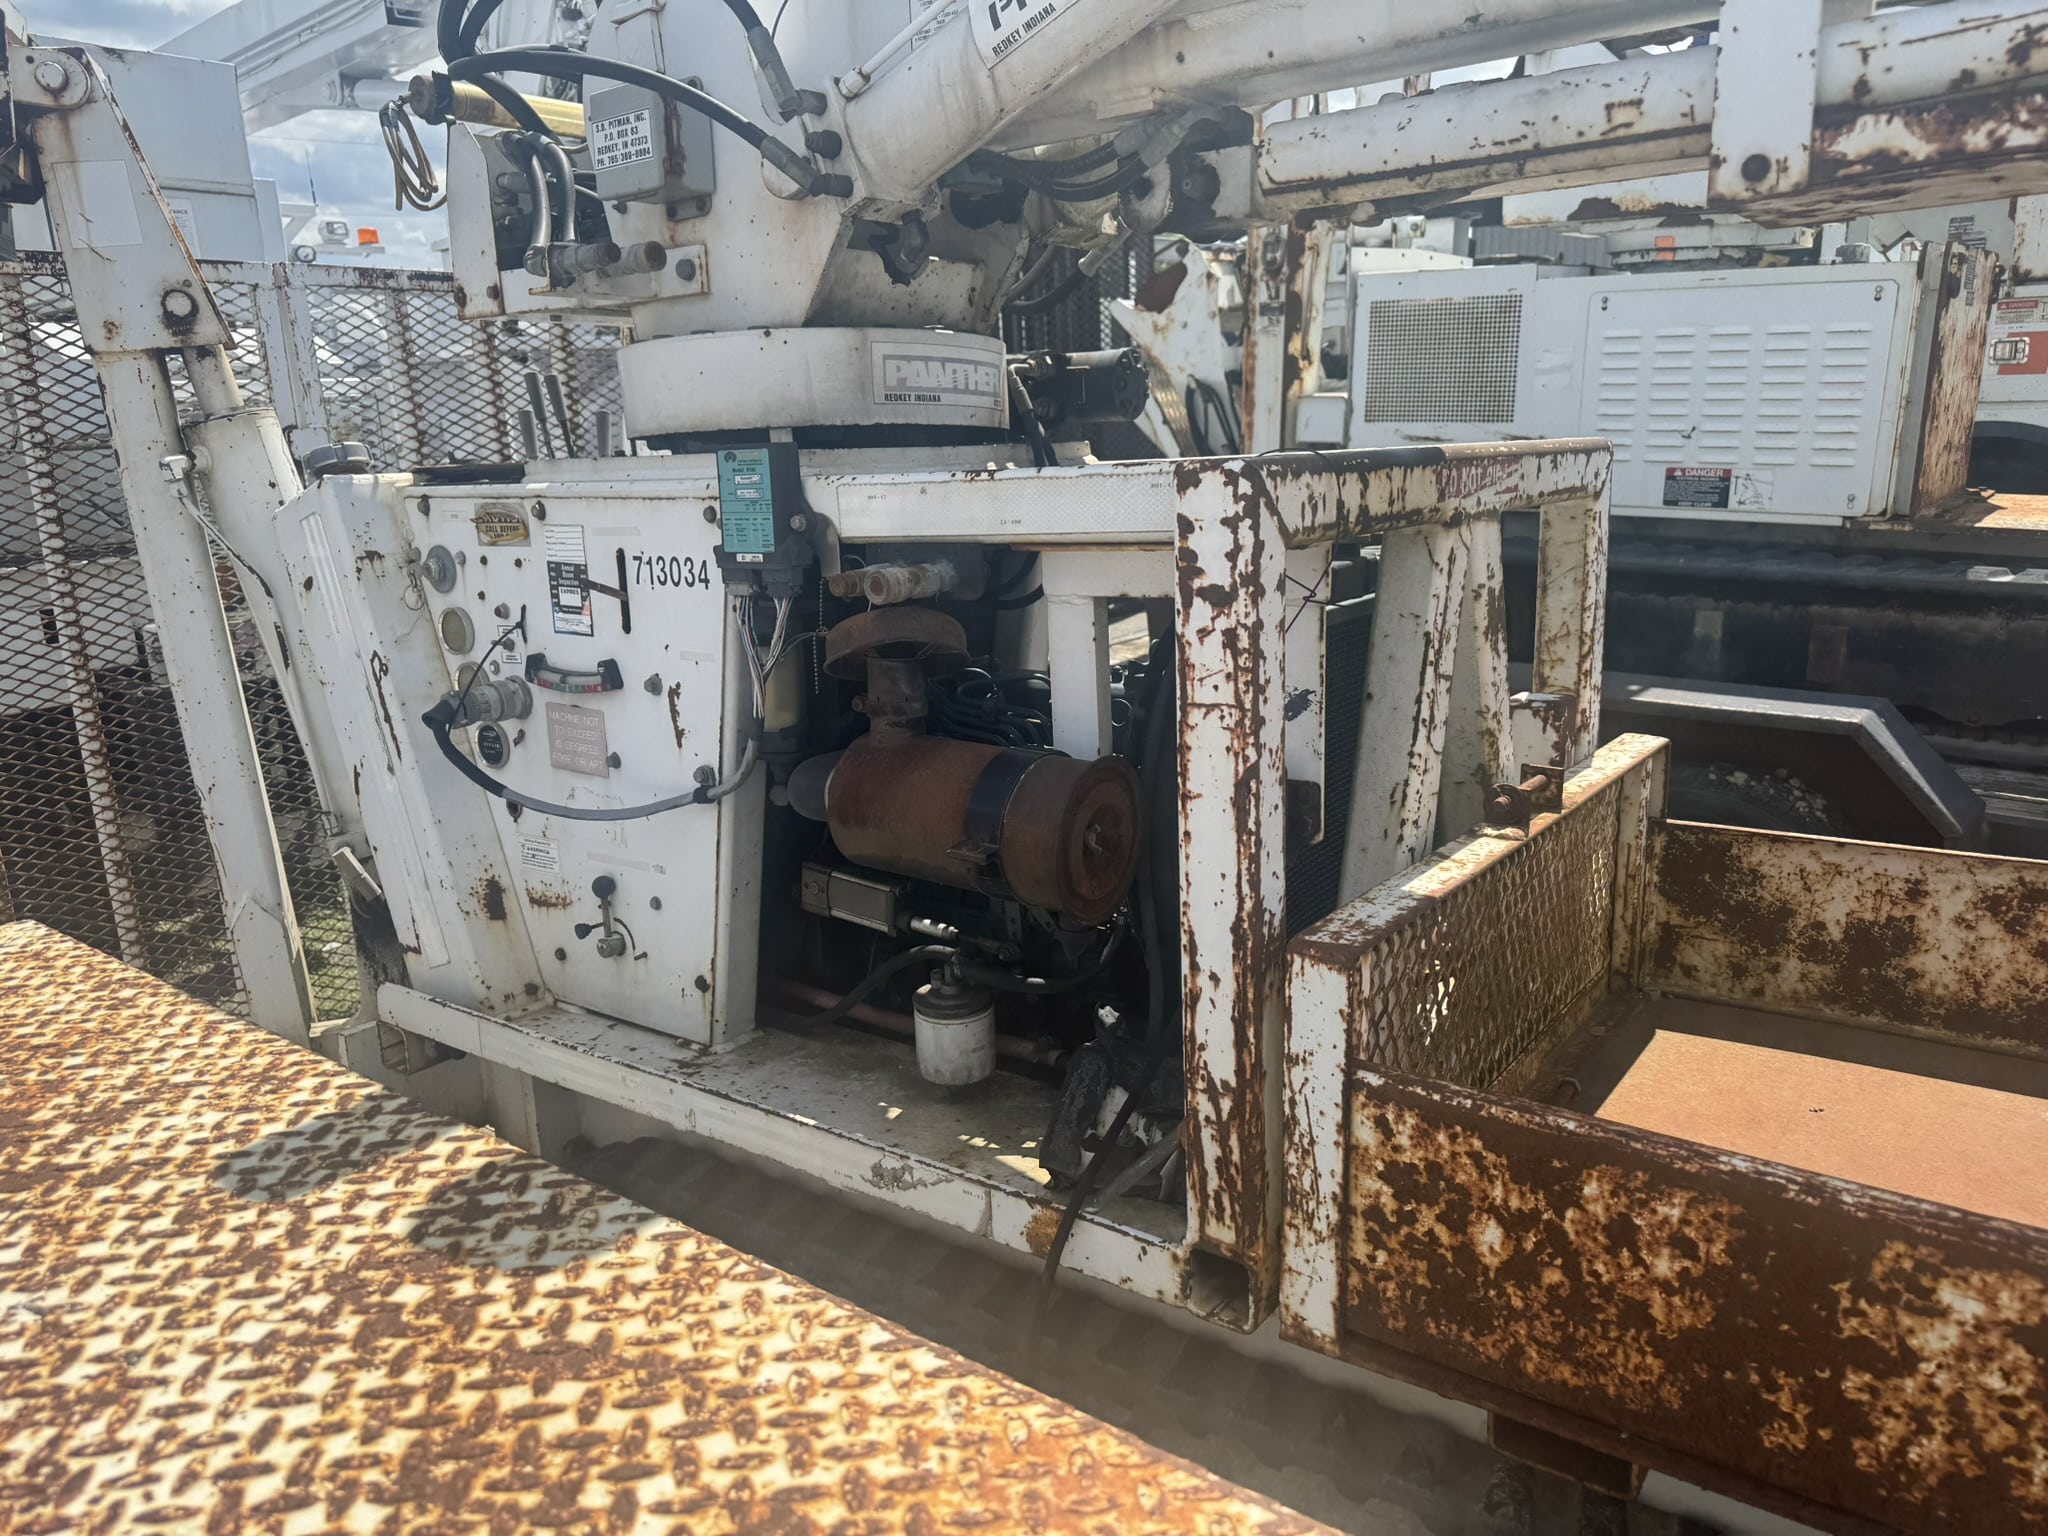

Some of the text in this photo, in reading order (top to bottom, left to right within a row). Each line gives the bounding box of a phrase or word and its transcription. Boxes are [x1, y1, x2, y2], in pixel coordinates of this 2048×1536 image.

[992, 2, 1057, 57] REDKEY INDIANA
[634, 112, 647, 123] INC.
[604, 131, 616, 143] P.O.
[617, 128, 629, 139] BOX
[621, 140, 629, 150] IN
[630, 135, 649, 147] 47373
[596, 158, 607, 168] PH.
[884, 393, 942, 403] REDKEY INDIANA
[1685, 468, 1724, 477] DANGER
[1461, 465, 1483, 495] NOT
[485, 525, 498, 533] CALL
[632, 555, 710, 590] 713034
[549, 711, 600, 727] MACHINE NOT
[554, 724, 597, 741] TO EXCEED
[565, 741, 599, 755] DEGREES
[575, 757, 586, 767] OR
[589, 759, 604, 770] AFT
